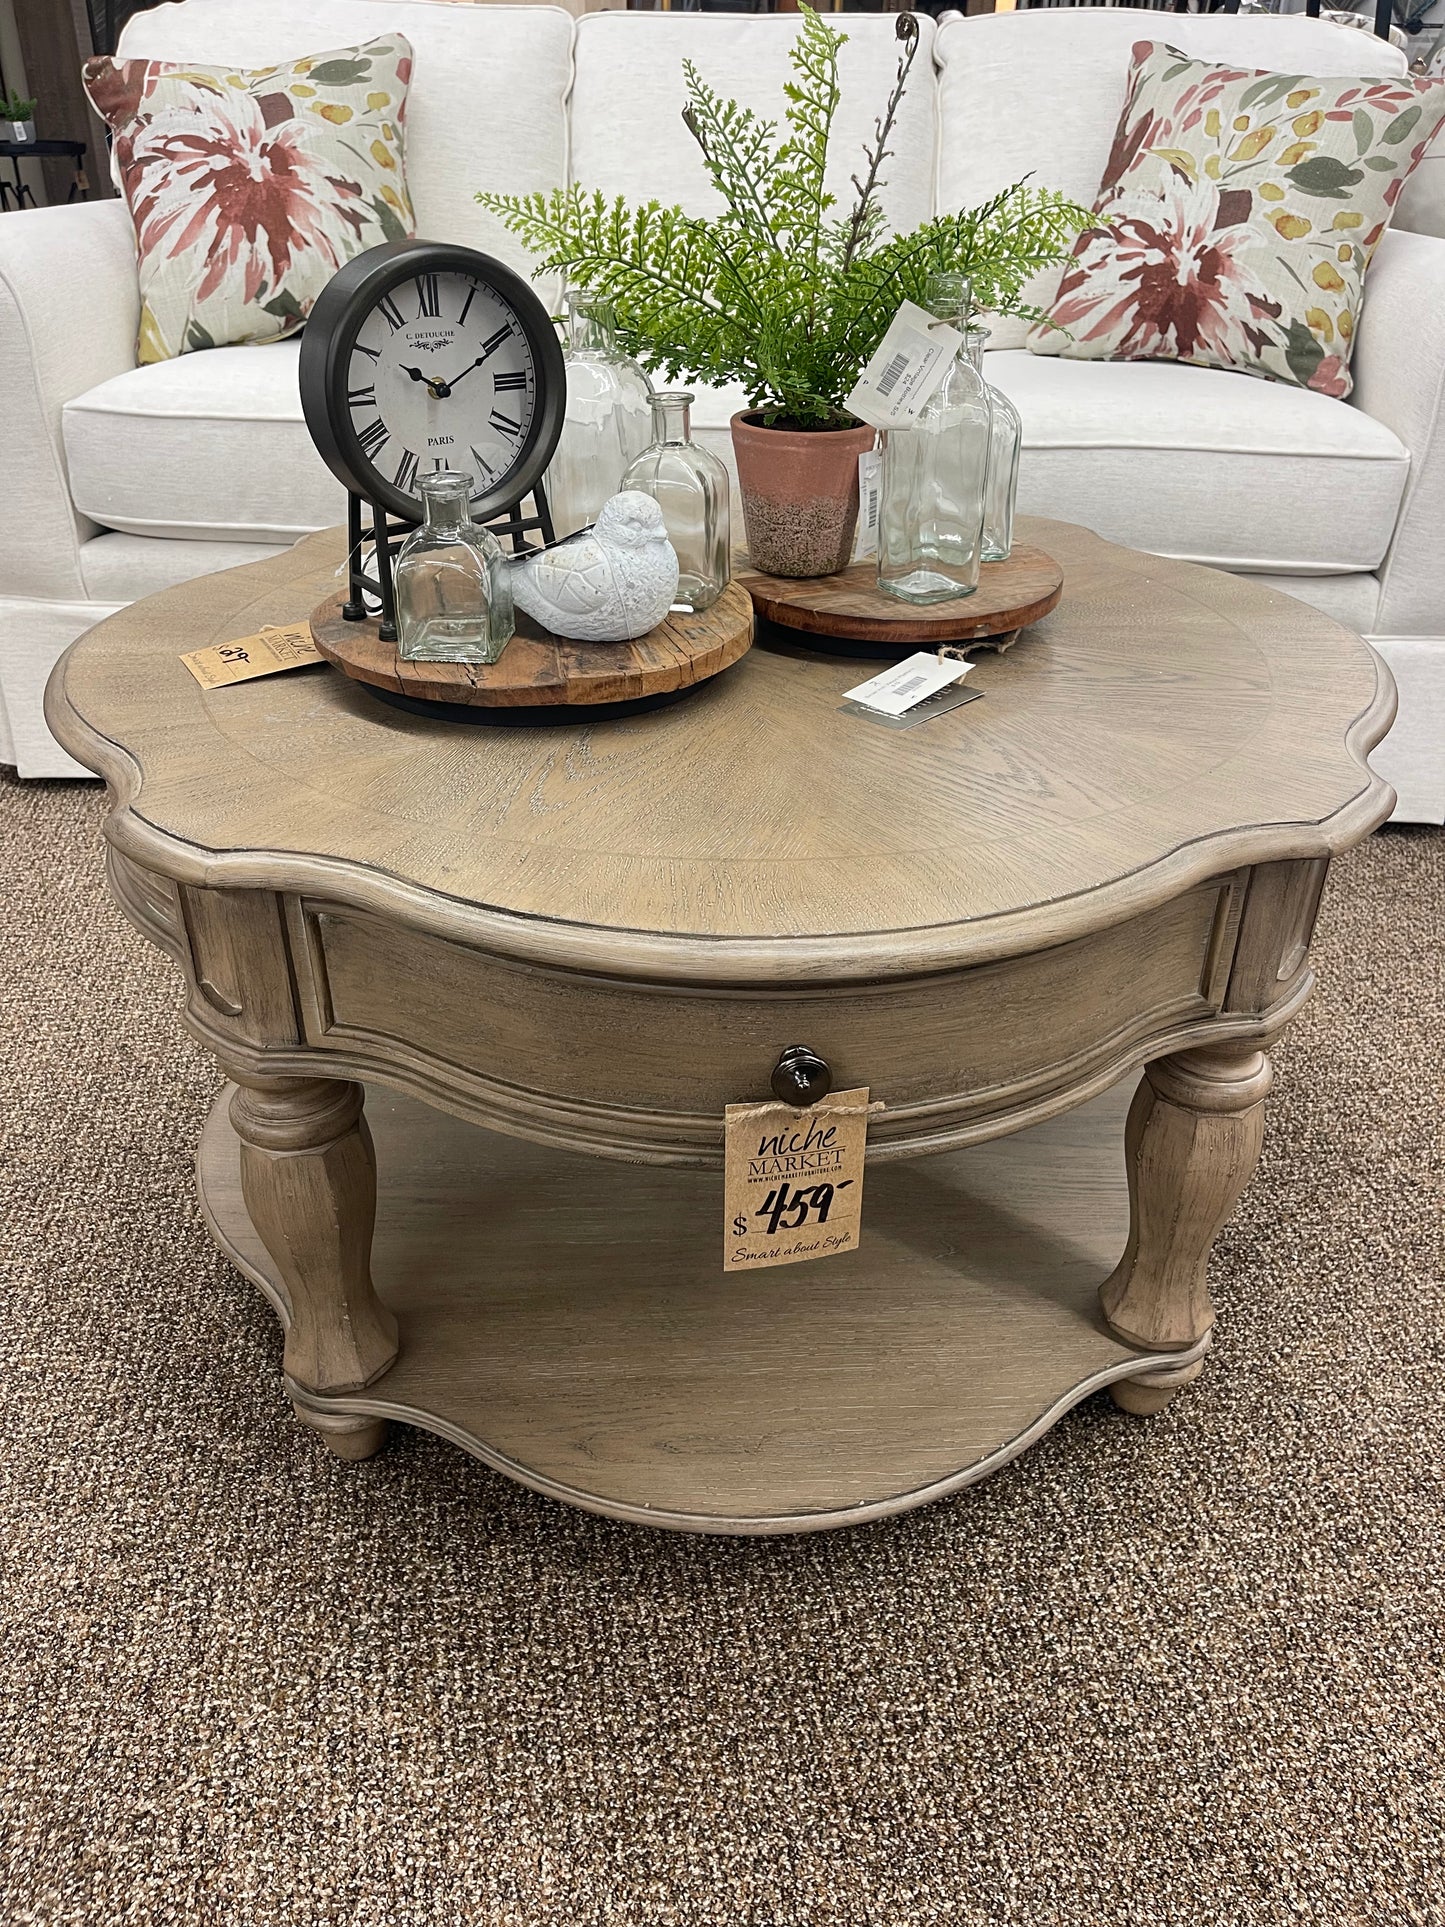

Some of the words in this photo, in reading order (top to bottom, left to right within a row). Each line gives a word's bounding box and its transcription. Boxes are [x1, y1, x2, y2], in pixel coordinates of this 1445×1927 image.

[416, 274, 443, 319] XII
[414, 330, 455, 340] DETOUCHE
[493, 369, 527, 395] III
[910, 365, 925, 385] Vintage
[427, 435, 455, 447] PARIS
[267, 634, 298, 661] MARKET
[758, 1117, 837, 1156] niche
[748, 1149, 845, 1176] MARKET
[748, 1164, 842, 1184] WWW.NICHEMARKETFURNITURE.COM
[732, 1212, 748, 1237] $
[731, 1247, 780, 1263] Smart
[784, 1241, 820, 1256] about
[822, 1231, 852, 1249] Style
